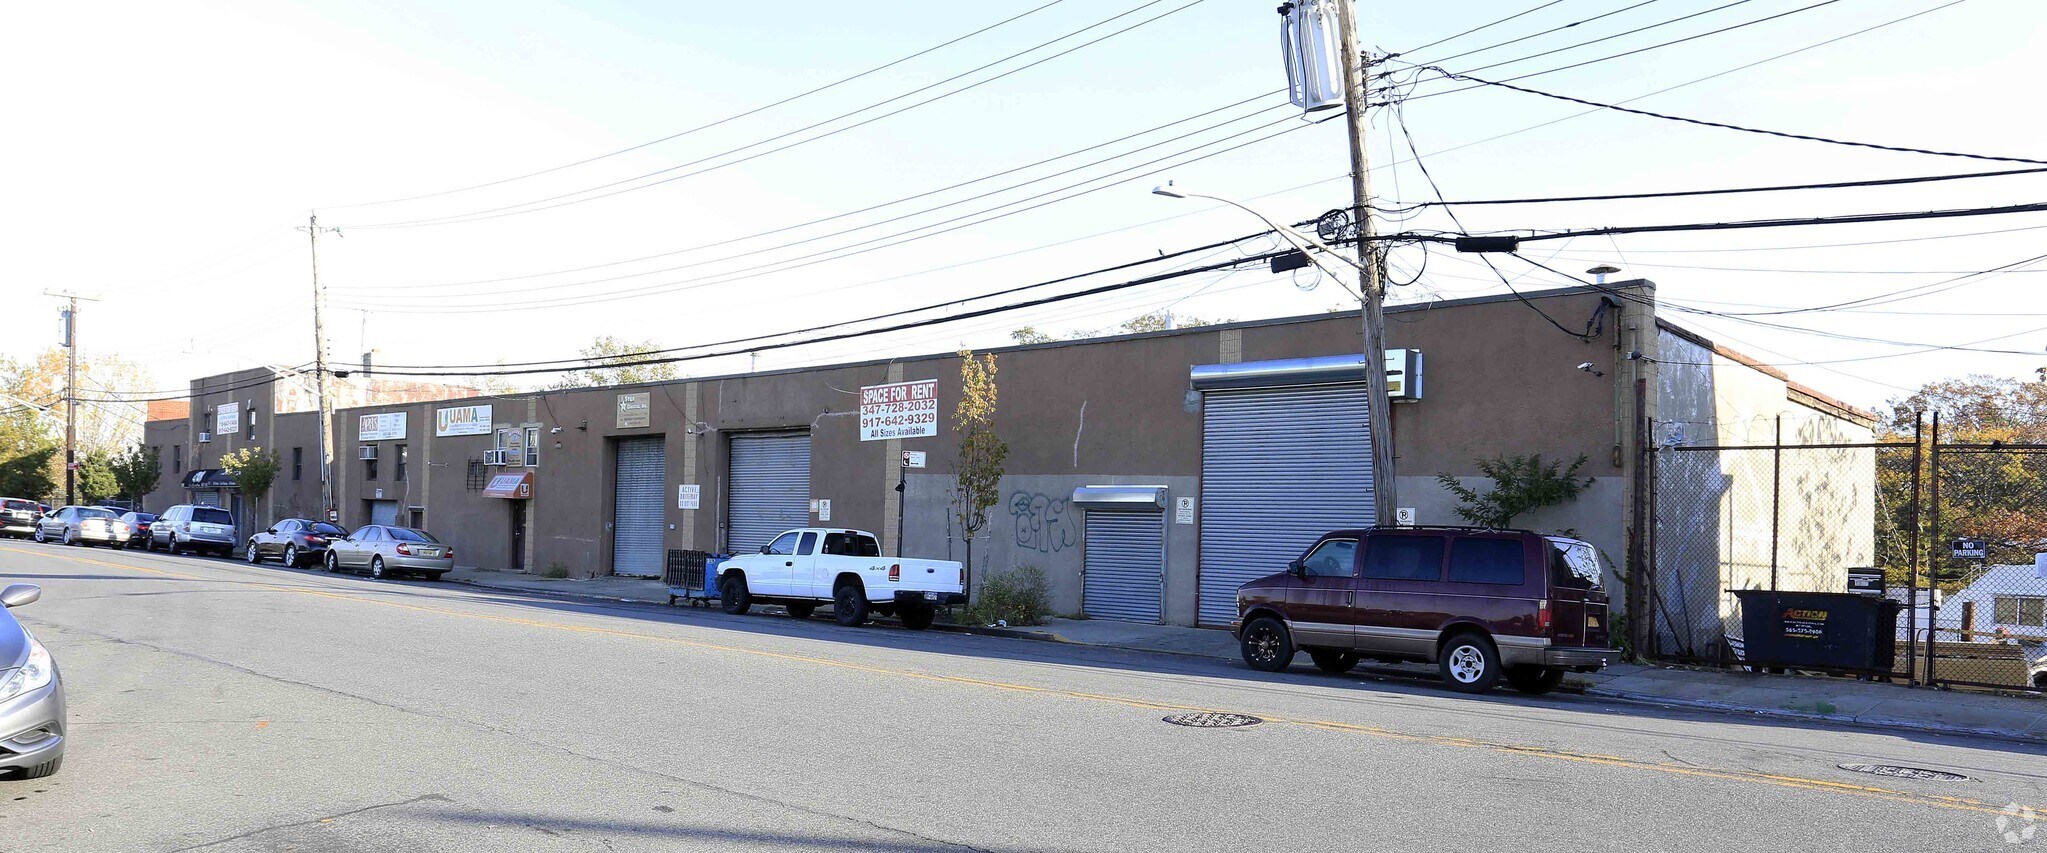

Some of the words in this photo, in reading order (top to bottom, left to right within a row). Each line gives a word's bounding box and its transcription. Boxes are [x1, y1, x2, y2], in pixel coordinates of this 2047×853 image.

[863, 388, 889, 404] SPACE
[890, 386, 907, 402] FOR
[911, 383, 935, 400] RENT
[862, 400, 935, 415] 347-728-2032
[449, 407, 479, 424] UAMA
[862, 413, 935, 428] 917-642-9329
[870, 429, 879, 438] All
[880, 428, 896, 437] Sizes
[897, 426, 926, 436] Available
[1953, 549, 1984, 557] PARKING
[1782, 607, 1828, 619] ACTION
